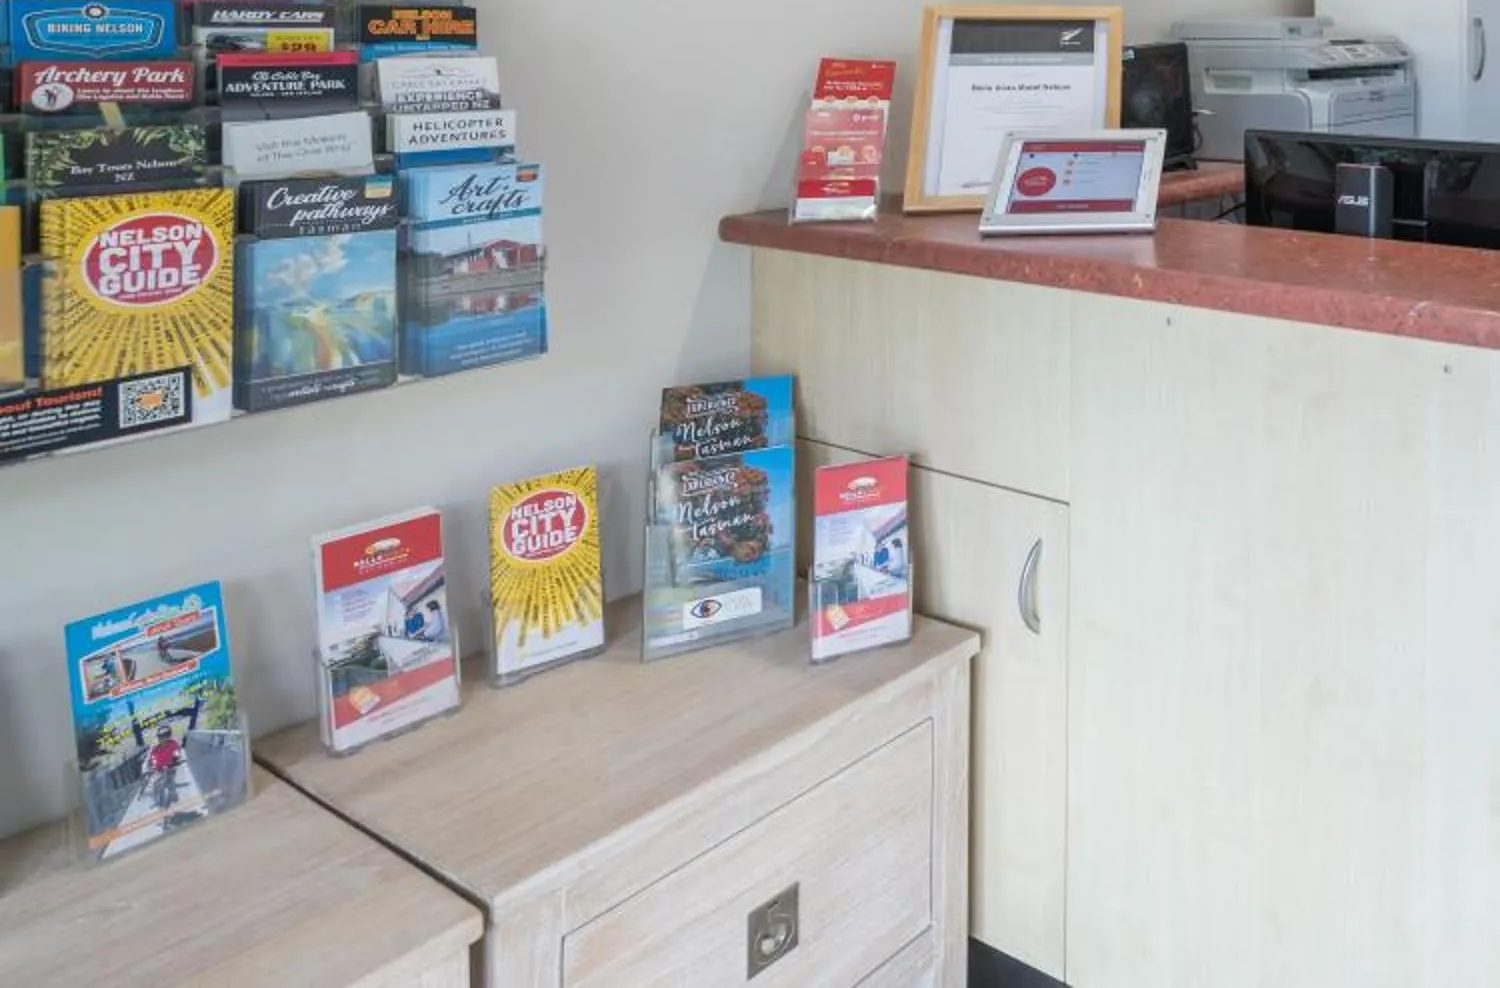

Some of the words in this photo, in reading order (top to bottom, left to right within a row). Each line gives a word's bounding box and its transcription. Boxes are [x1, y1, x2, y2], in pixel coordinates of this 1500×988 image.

[95, 22, 144, 34] NELSON
[368, 19, 416, 35] CAR
[422, 19, 475, 36] HIRE
[34, 66, 126, 87] Archery
[131, 67, 186, 84] Park
[225, 81, 307, 94] ADVENTURE
[310, 78, 346, 90] PARK
[409, 130, 507, 145] ADVENTURES
[413, 117, 504, 132] HELICOPTER
[266, 184, 358, 211] Creative
[451, 187, 531, 221] crafts
[1337, 195, 1369, 207] ASUS
[289, 202, 395, 228] pathways
[100, 223, 205, 249] NELSON
[100, 238, 201, 276] CITY
[100, 263, 204, 296] GUIDE
[676, 415, 742, 443] Nelson
[694, 437, 753, 460] Tasman
[511, 492, 577, 520] NELSON
[679, 492, 741, 524] Nelson
[511, 506, 577, 540] CITY
[689, 512, 753, 539] Tasman
[511, 526, 578, 555] GUIDE
